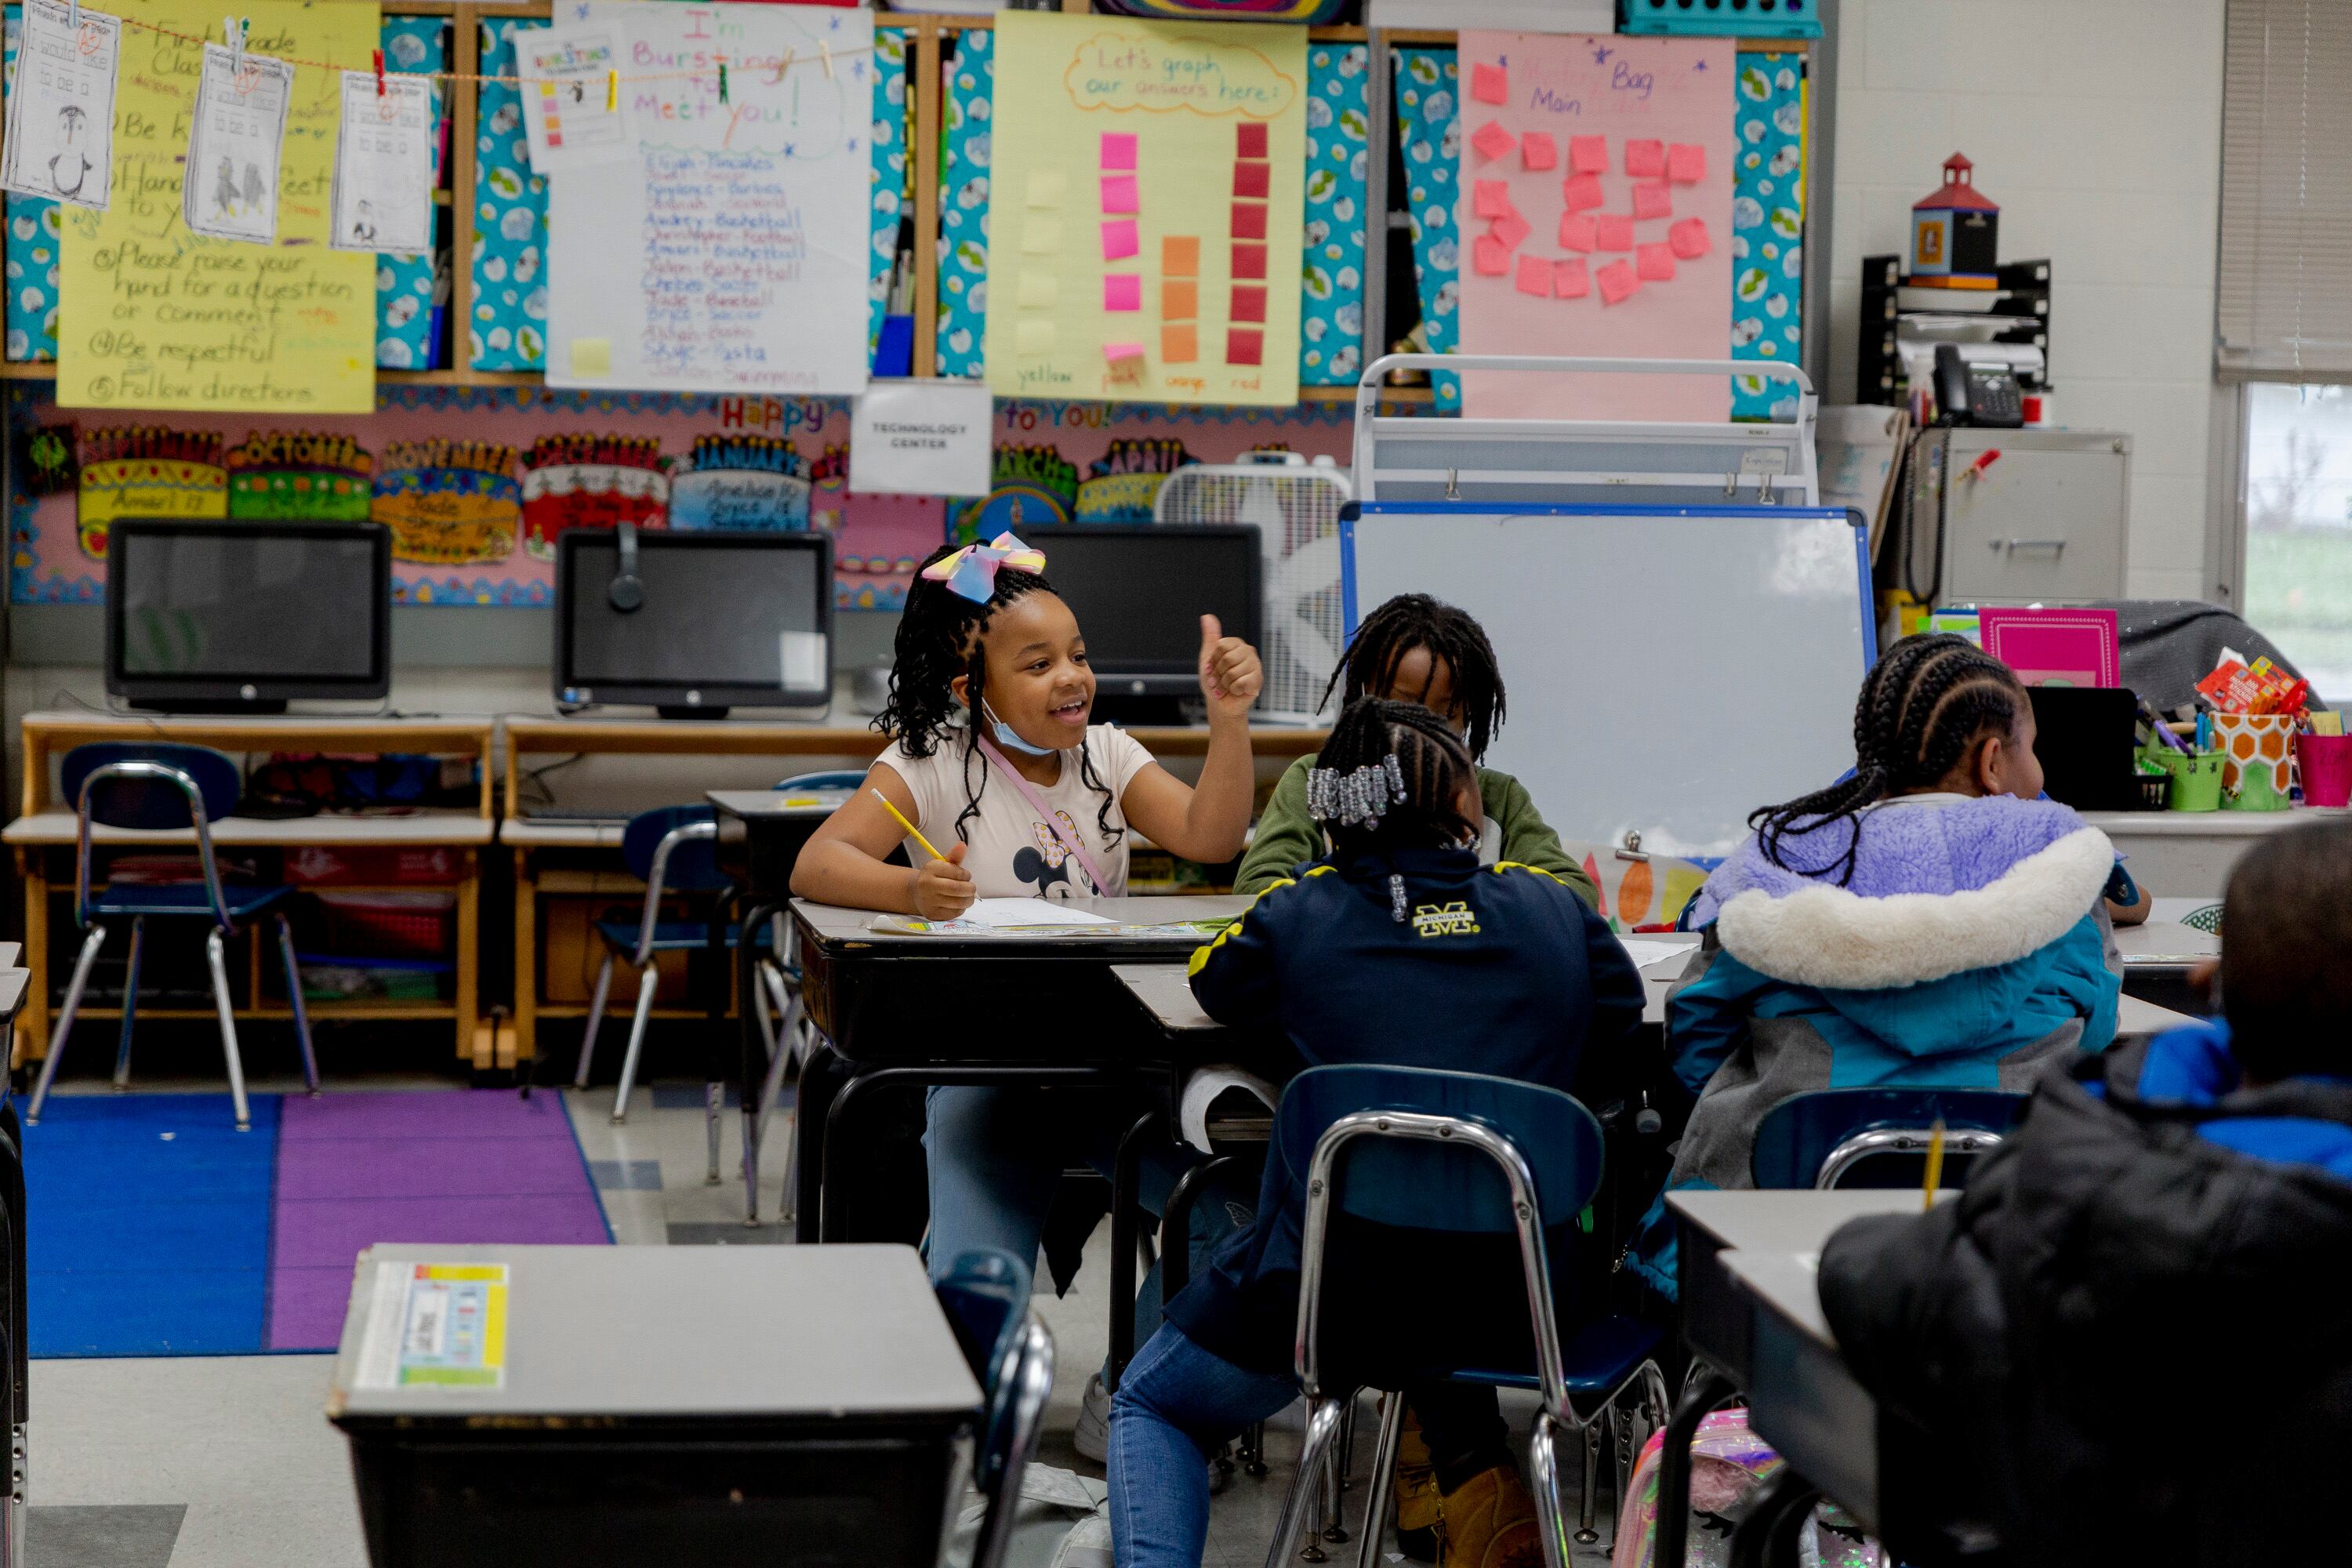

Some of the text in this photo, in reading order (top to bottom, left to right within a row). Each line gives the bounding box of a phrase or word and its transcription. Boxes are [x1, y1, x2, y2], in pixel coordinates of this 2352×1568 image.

[682, 9, 744, 39] I'm
[152, 49, 202, 76] Clas
[632, 40, 784, 86] Bursting
[1098, 48, 1221, 82] Let's graph
[690, 75, 719, 94] to
[1085, 78, 1120, 94] our
[1136, 80, 1209, 97] answers
[1611, 61, 1654, 100] Bag
[634, 93, 714, 121] Meet
[1530, 87, 1581, 115] Main
[125, 112, 156, 140] Be
[125, 192, 154, 217] to
[118, 238, 183, 270] Please
[192, 253, 246, 272] raise
[256, 255, 306, 283] your
[114, 269, 171, 299] hand
[183, 269, 217, 297] for
[113, 304, 140, 320] or
[156, 301, 280, 325] comment
[115, 330, 147, 358] Be
[158, 328, 277, 372] respectful
[119, 369, 192, 399] Follow
[1018, 364, 1072, 390] yellow
[1231, 370, 1261, 391] red
[723, 395, 1113, 437] Happy to YOU!
[871, 421, 967, 435] TECHNOLOGY
[890, 437, 947, 449] CENTER
[695, 445, 800, 473] JANUARY
[997, 452, 1059, 478] ARCH
[1422, 913, 1465, 922] MICHIGAN
